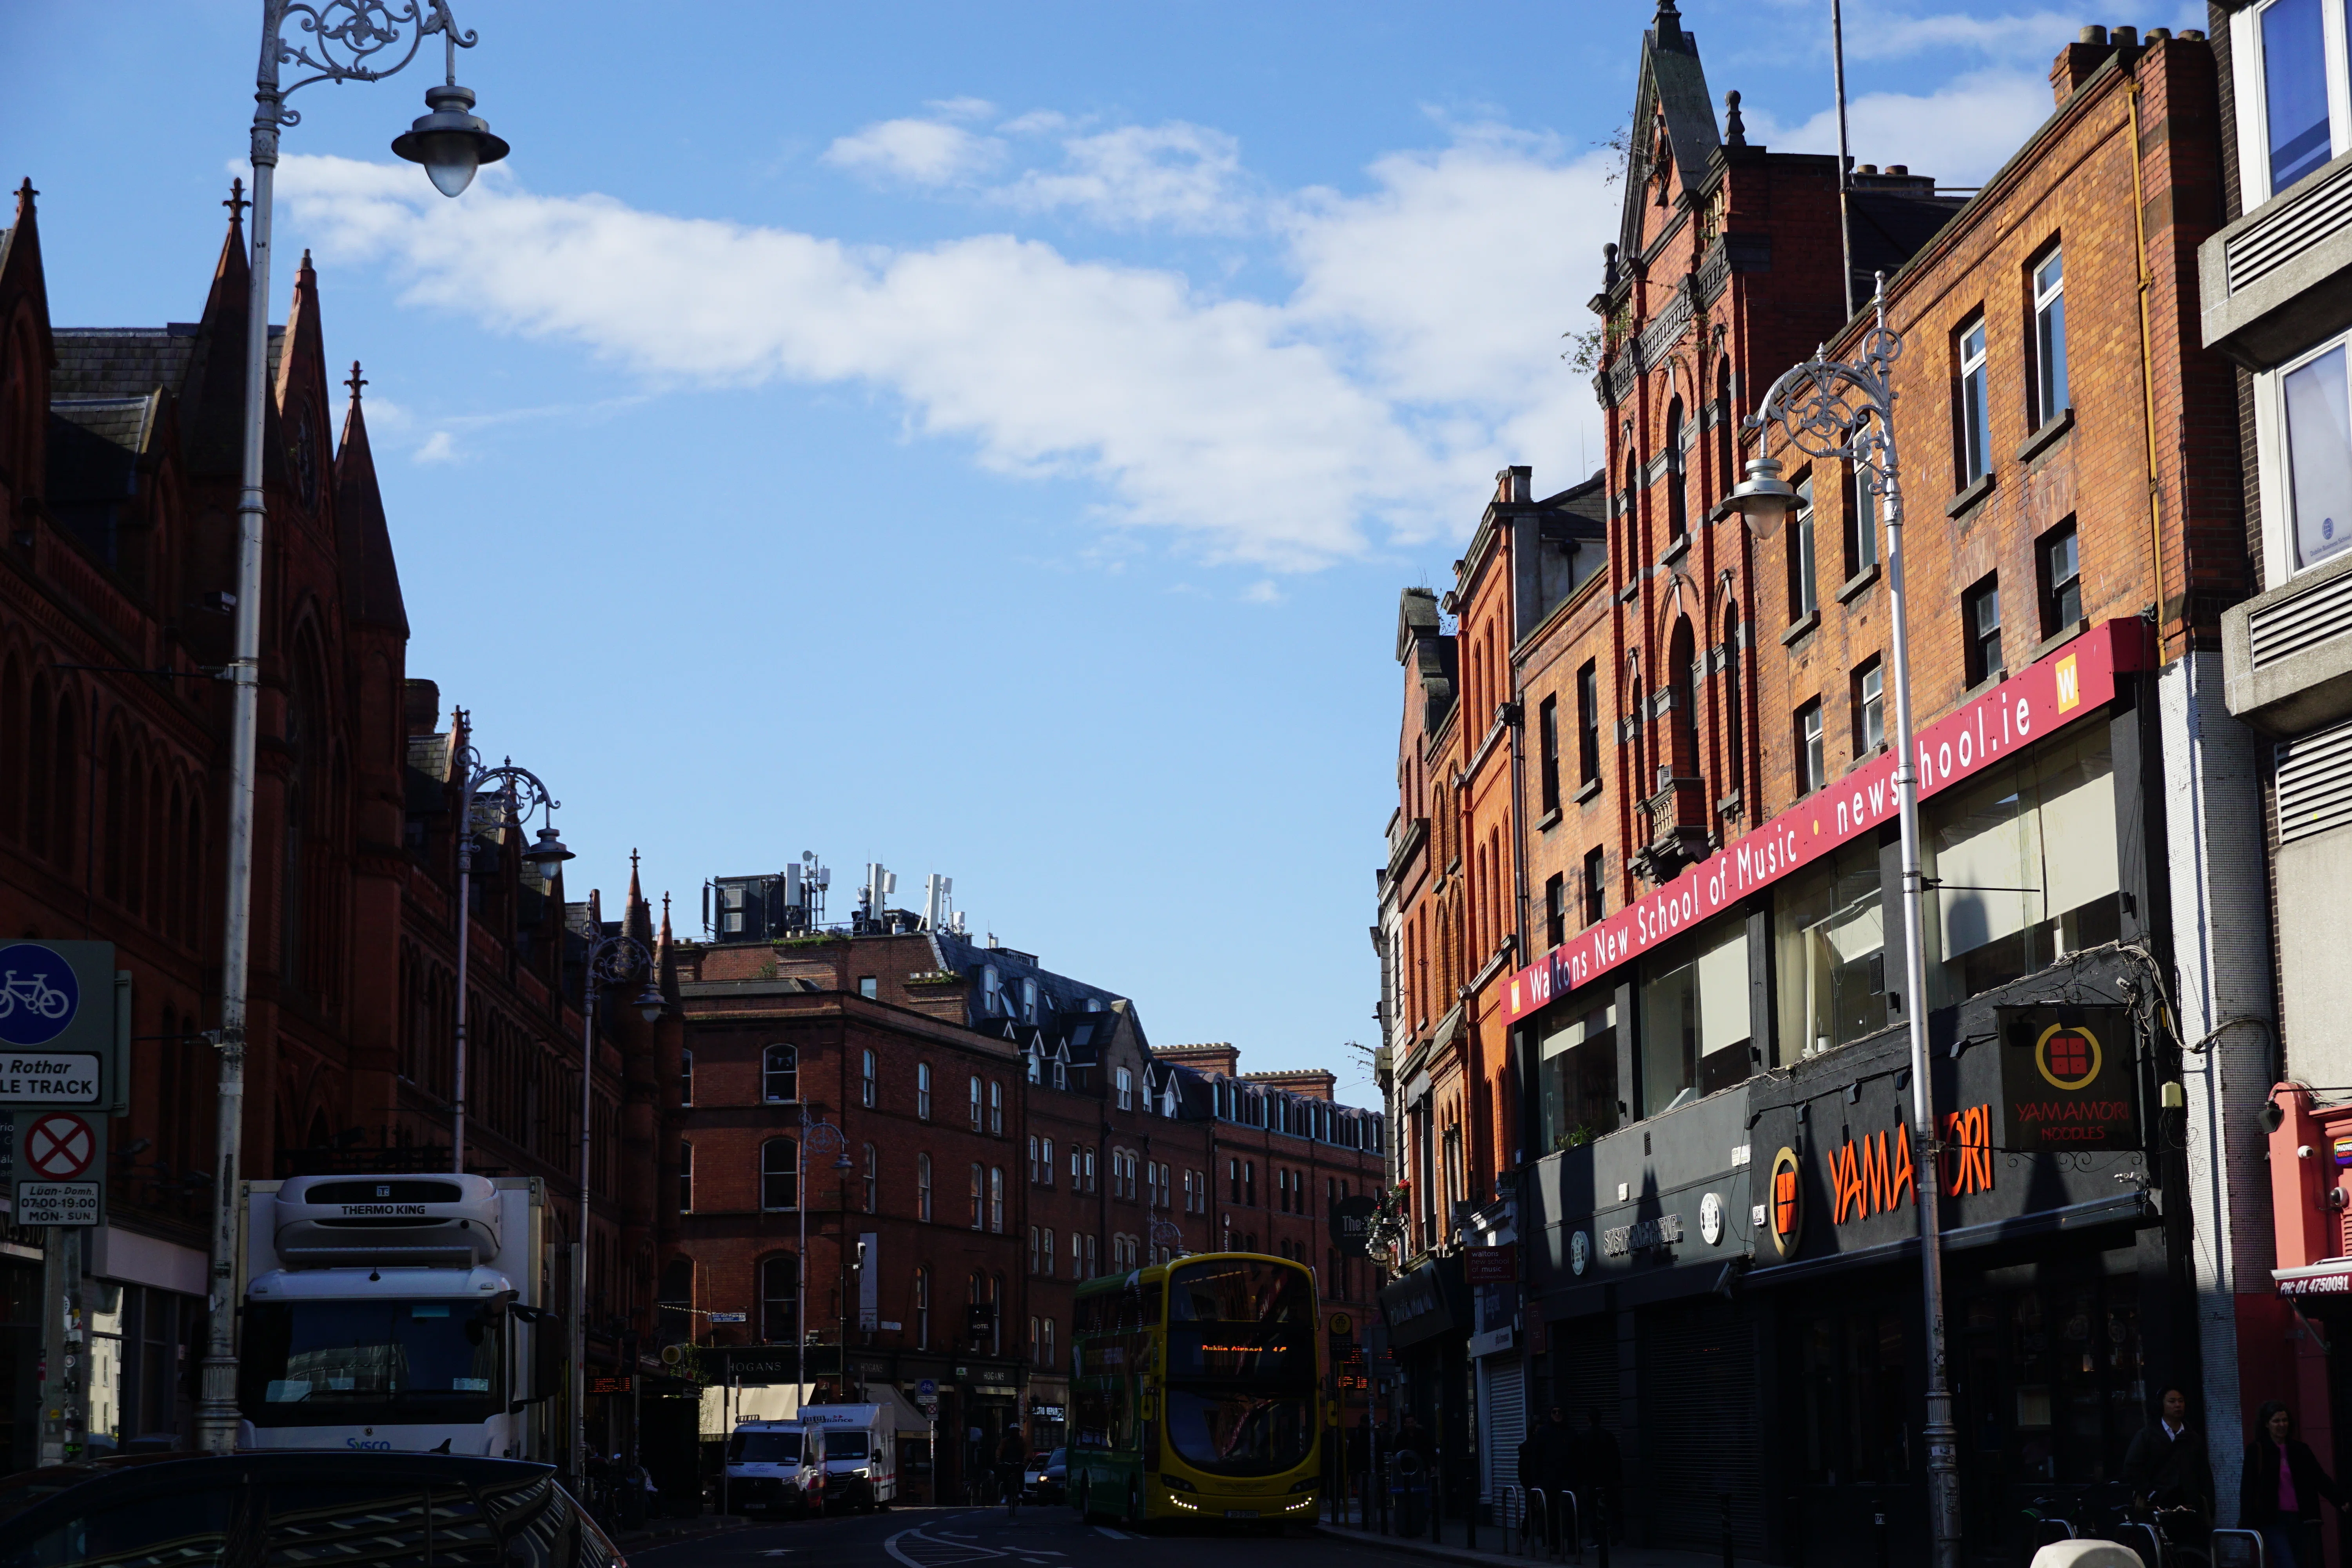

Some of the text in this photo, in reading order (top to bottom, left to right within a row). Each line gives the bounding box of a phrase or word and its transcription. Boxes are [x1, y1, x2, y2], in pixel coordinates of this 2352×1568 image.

[1530, 950, 1587, 1004] Waltons
[1595, 926, 1628, 969] New
[1638, 874, 1699, 945] School
[1710, 857, 1726, 905] of
[1737, 824, 1797, 890] Music
[1837, 692, 2030, 835] newshool.ie
[10, 1060, 71, 1073] Rothar
[28, 1080, 93, 1094] TRACK
[2015, 1101, 2129, 1122] YAMAMORI
[2042, 1125, 2105, 1140] NOODLES
[22, 1198, 96, 1207] 07:00-19:00
[342, 1205, 425, 1215] THERMO KING
[1648, 1214, 1678, 1254] GRENE
[2281, 1275, 2349, 1295] PH: 01 4750091
[860, 1362, 883, 1373] HOGANS
[984, 1371, 1004, 1381] HOGANS
